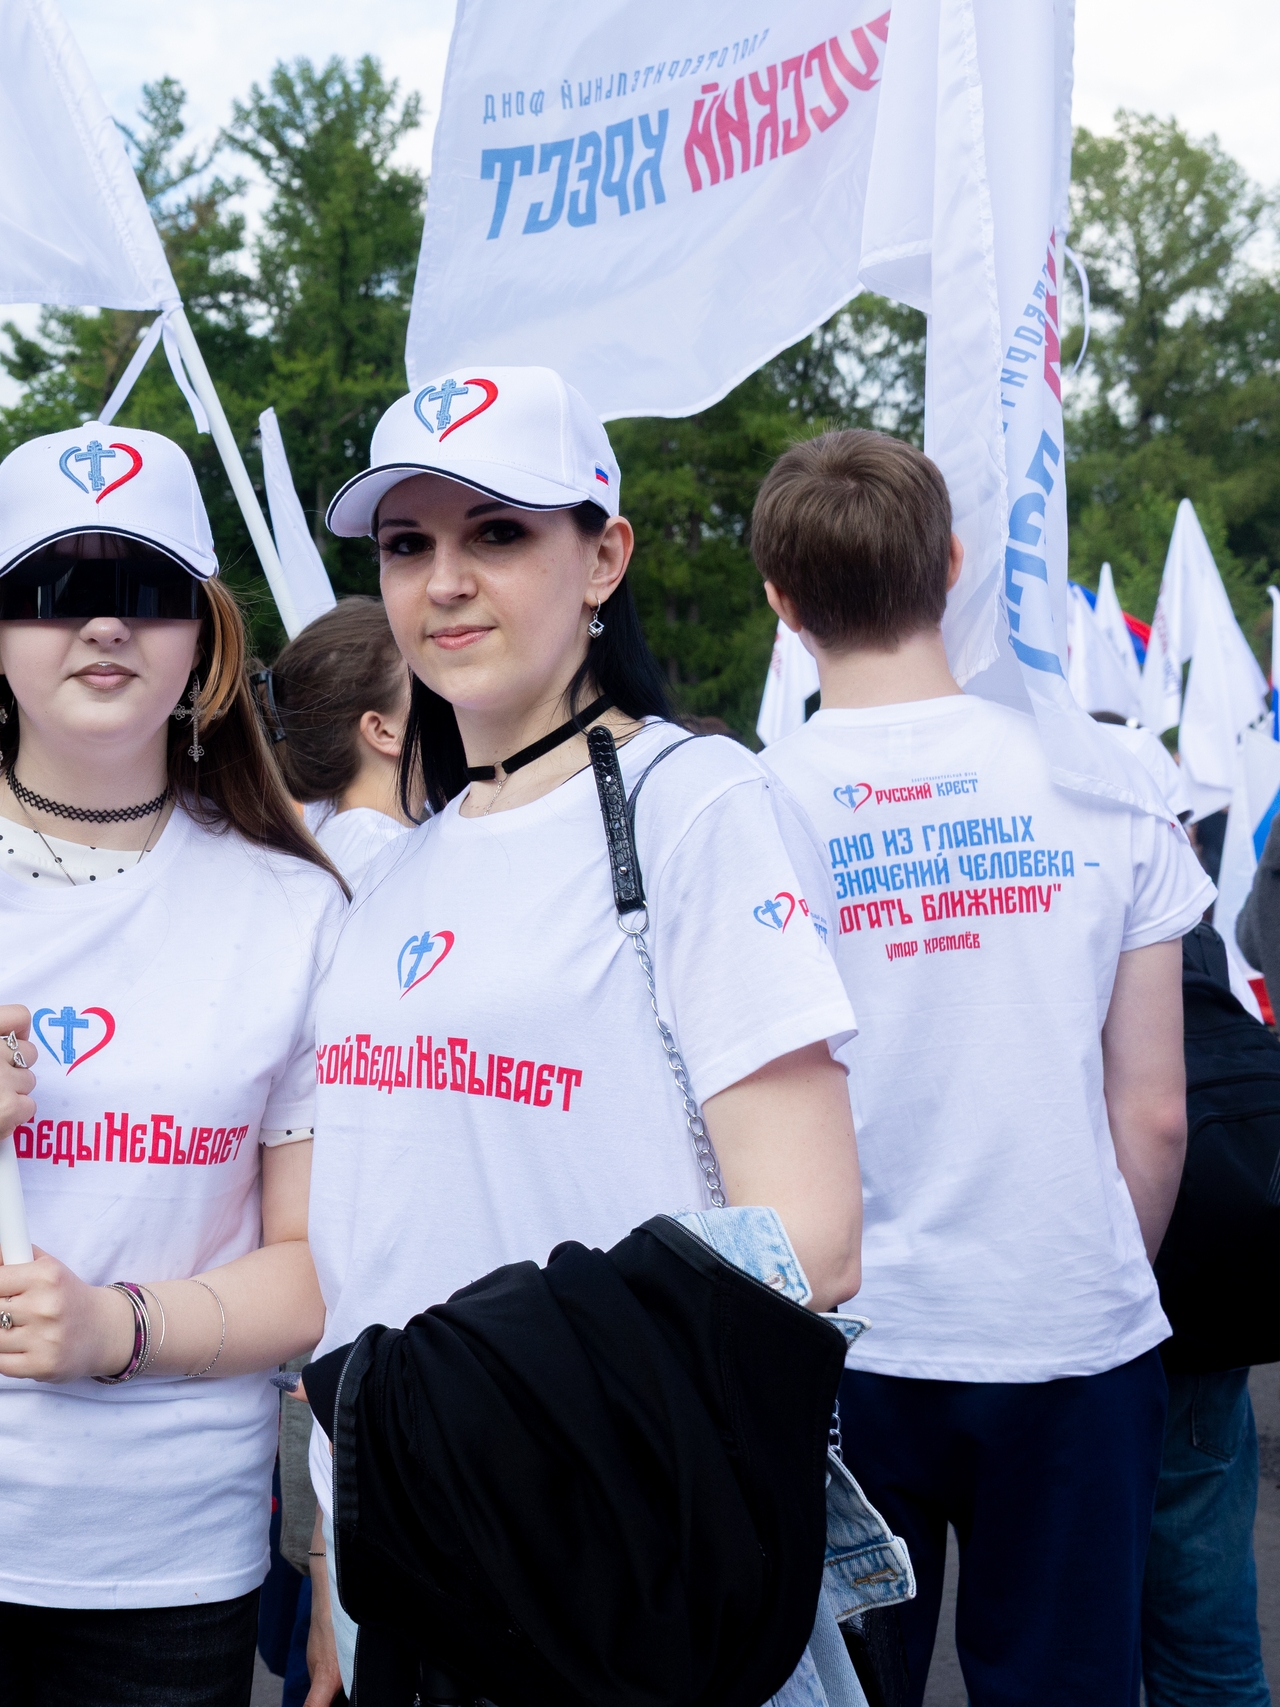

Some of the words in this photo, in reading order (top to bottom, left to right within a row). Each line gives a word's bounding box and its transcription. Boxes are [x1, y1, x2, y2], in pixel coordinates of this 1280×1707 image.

[875, 782, 932, 805] РУССКИЙ
[936, 779, 978, 797] КРЕСТ
[828, 833, 875, 869] ДНО
[882, 827, 913, 857] ИЗ
[922, 815, 1035, 851] ГЛАВНЫХ
[833, 852, 950, 899] ЗНАЧЕНИЙ
[959, 850, 1075, 881] ЧЕЛОВЕКА
[838, 898, 913, 935] ОГАТЬ
[921, 883, 1061, 922] БЛИЖНЕМУ"
[885, 940, 918, 961] УМАР
[923, 931, 980, 954] КРЕМЛЁВ
